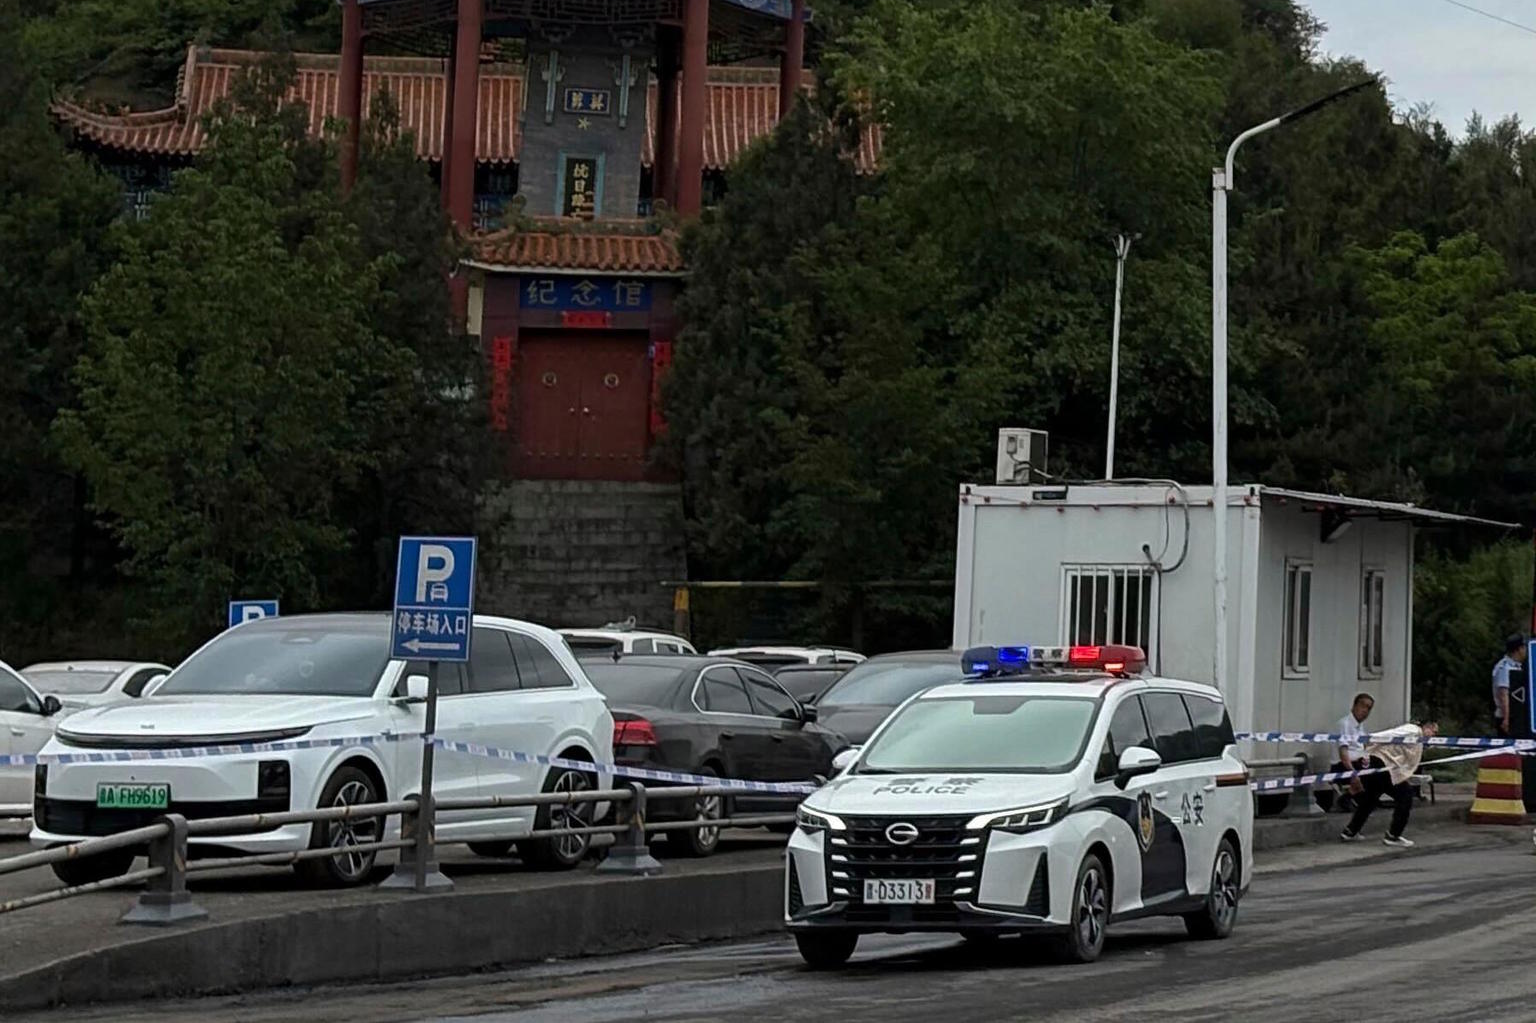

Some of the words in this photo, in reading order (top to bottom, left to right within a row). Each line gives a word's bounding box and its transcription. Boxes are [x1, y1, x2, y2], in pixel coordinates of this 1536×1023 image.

[527, 279, 645, 306] 纪念馆
[416, 544, 455, 602] P
[242, 606, 265, 624] P
[398, 612, 466, 635] 停车场入口
[873, 786, 971, 796] POLICE
[1181, 791, 1204, 825] 公安
